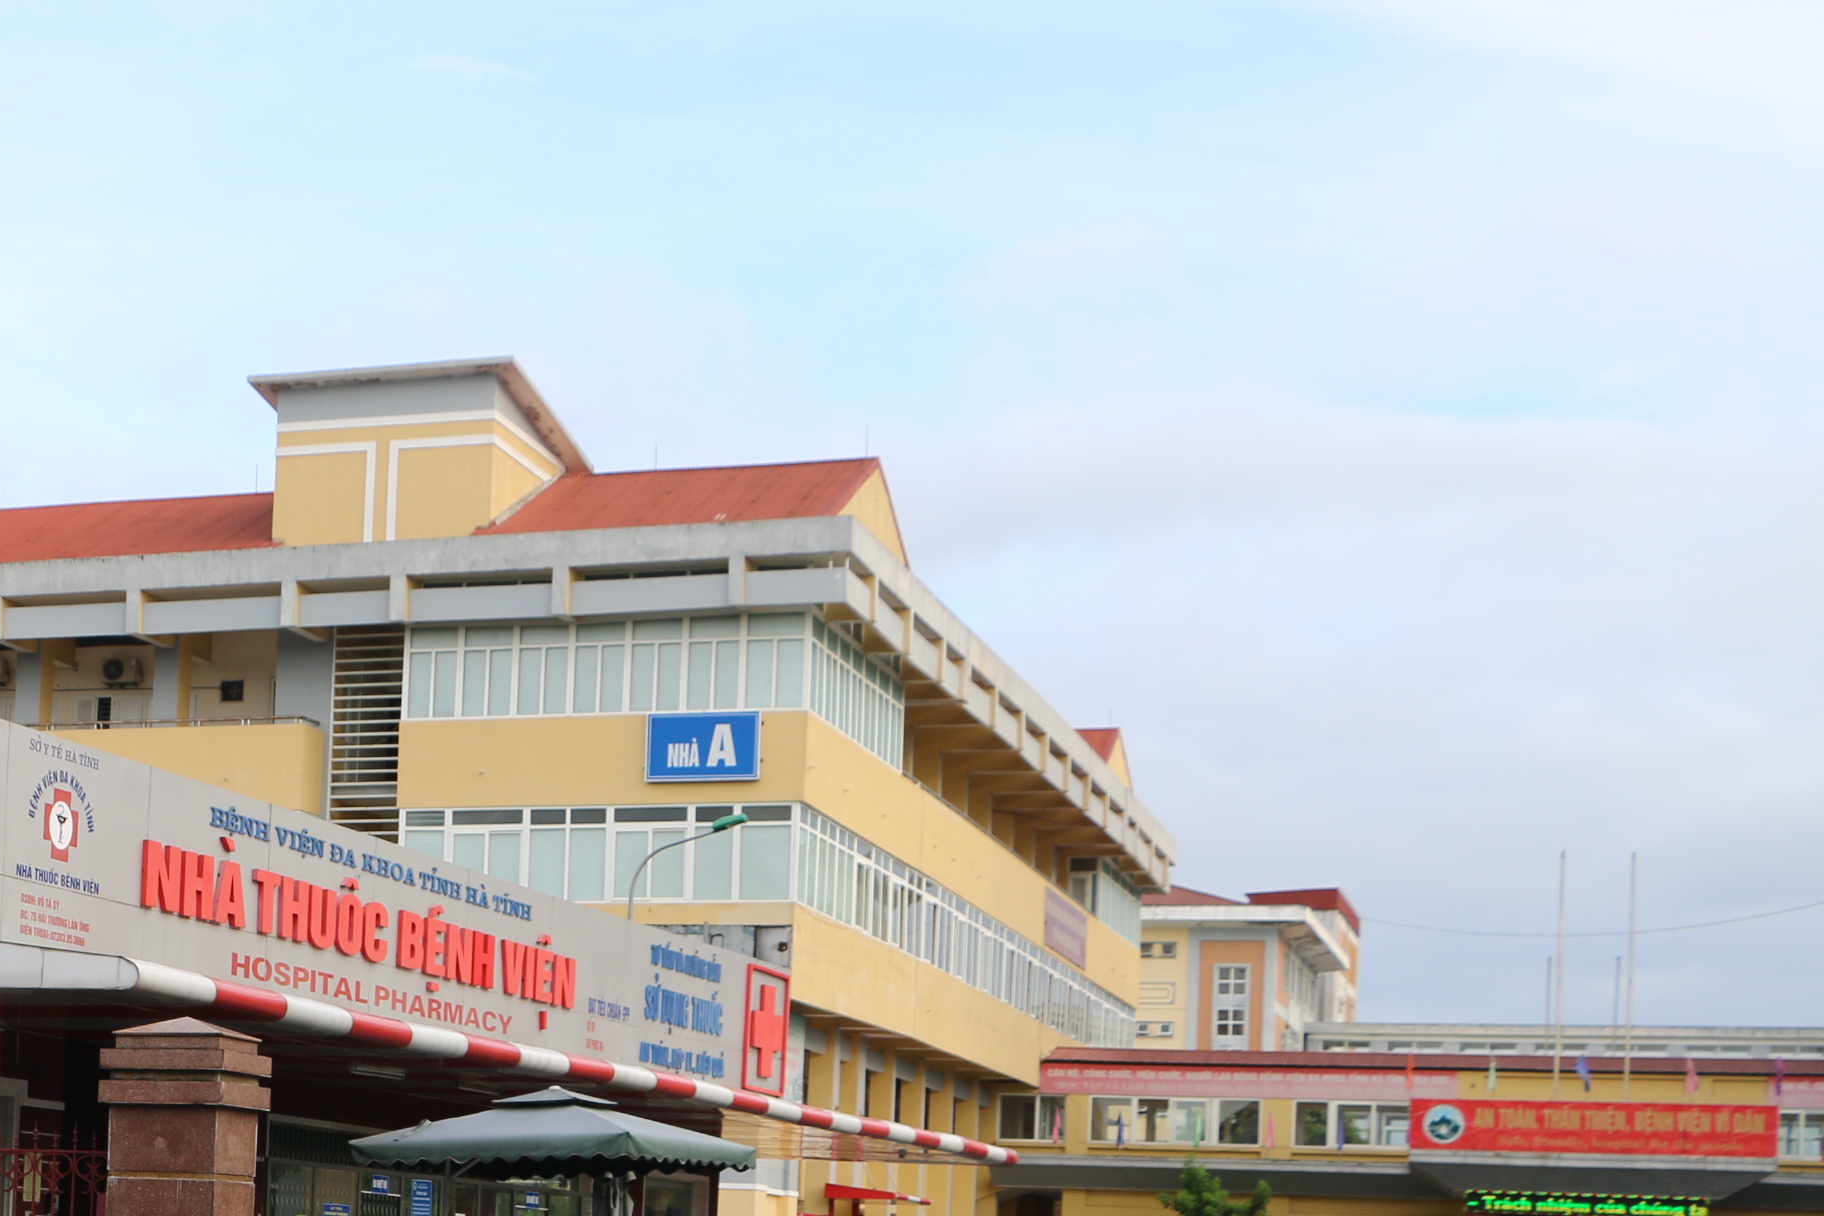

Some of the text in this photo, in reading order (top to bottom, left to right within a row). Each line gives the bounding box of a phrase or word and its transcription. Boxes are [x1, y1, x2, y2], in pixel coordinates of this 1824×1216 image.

[43, 743, 49, 755] Y
[667, 723, 737, 768] NHÀ A
[210, 806, 271, 842] BỆNH
[275, 826, 326, 858] VIỆN
[329, 843, 357, 868] ĐA
[361, 852, 417, 886] KHOA
[465, 884, 490, 909] HÀ
[141, 836, 246, 929] NHÀ
[501, 933, 577, 1031] VIỆN
[231, 951, 514, 1036] HOSPITAL PHARMACY
